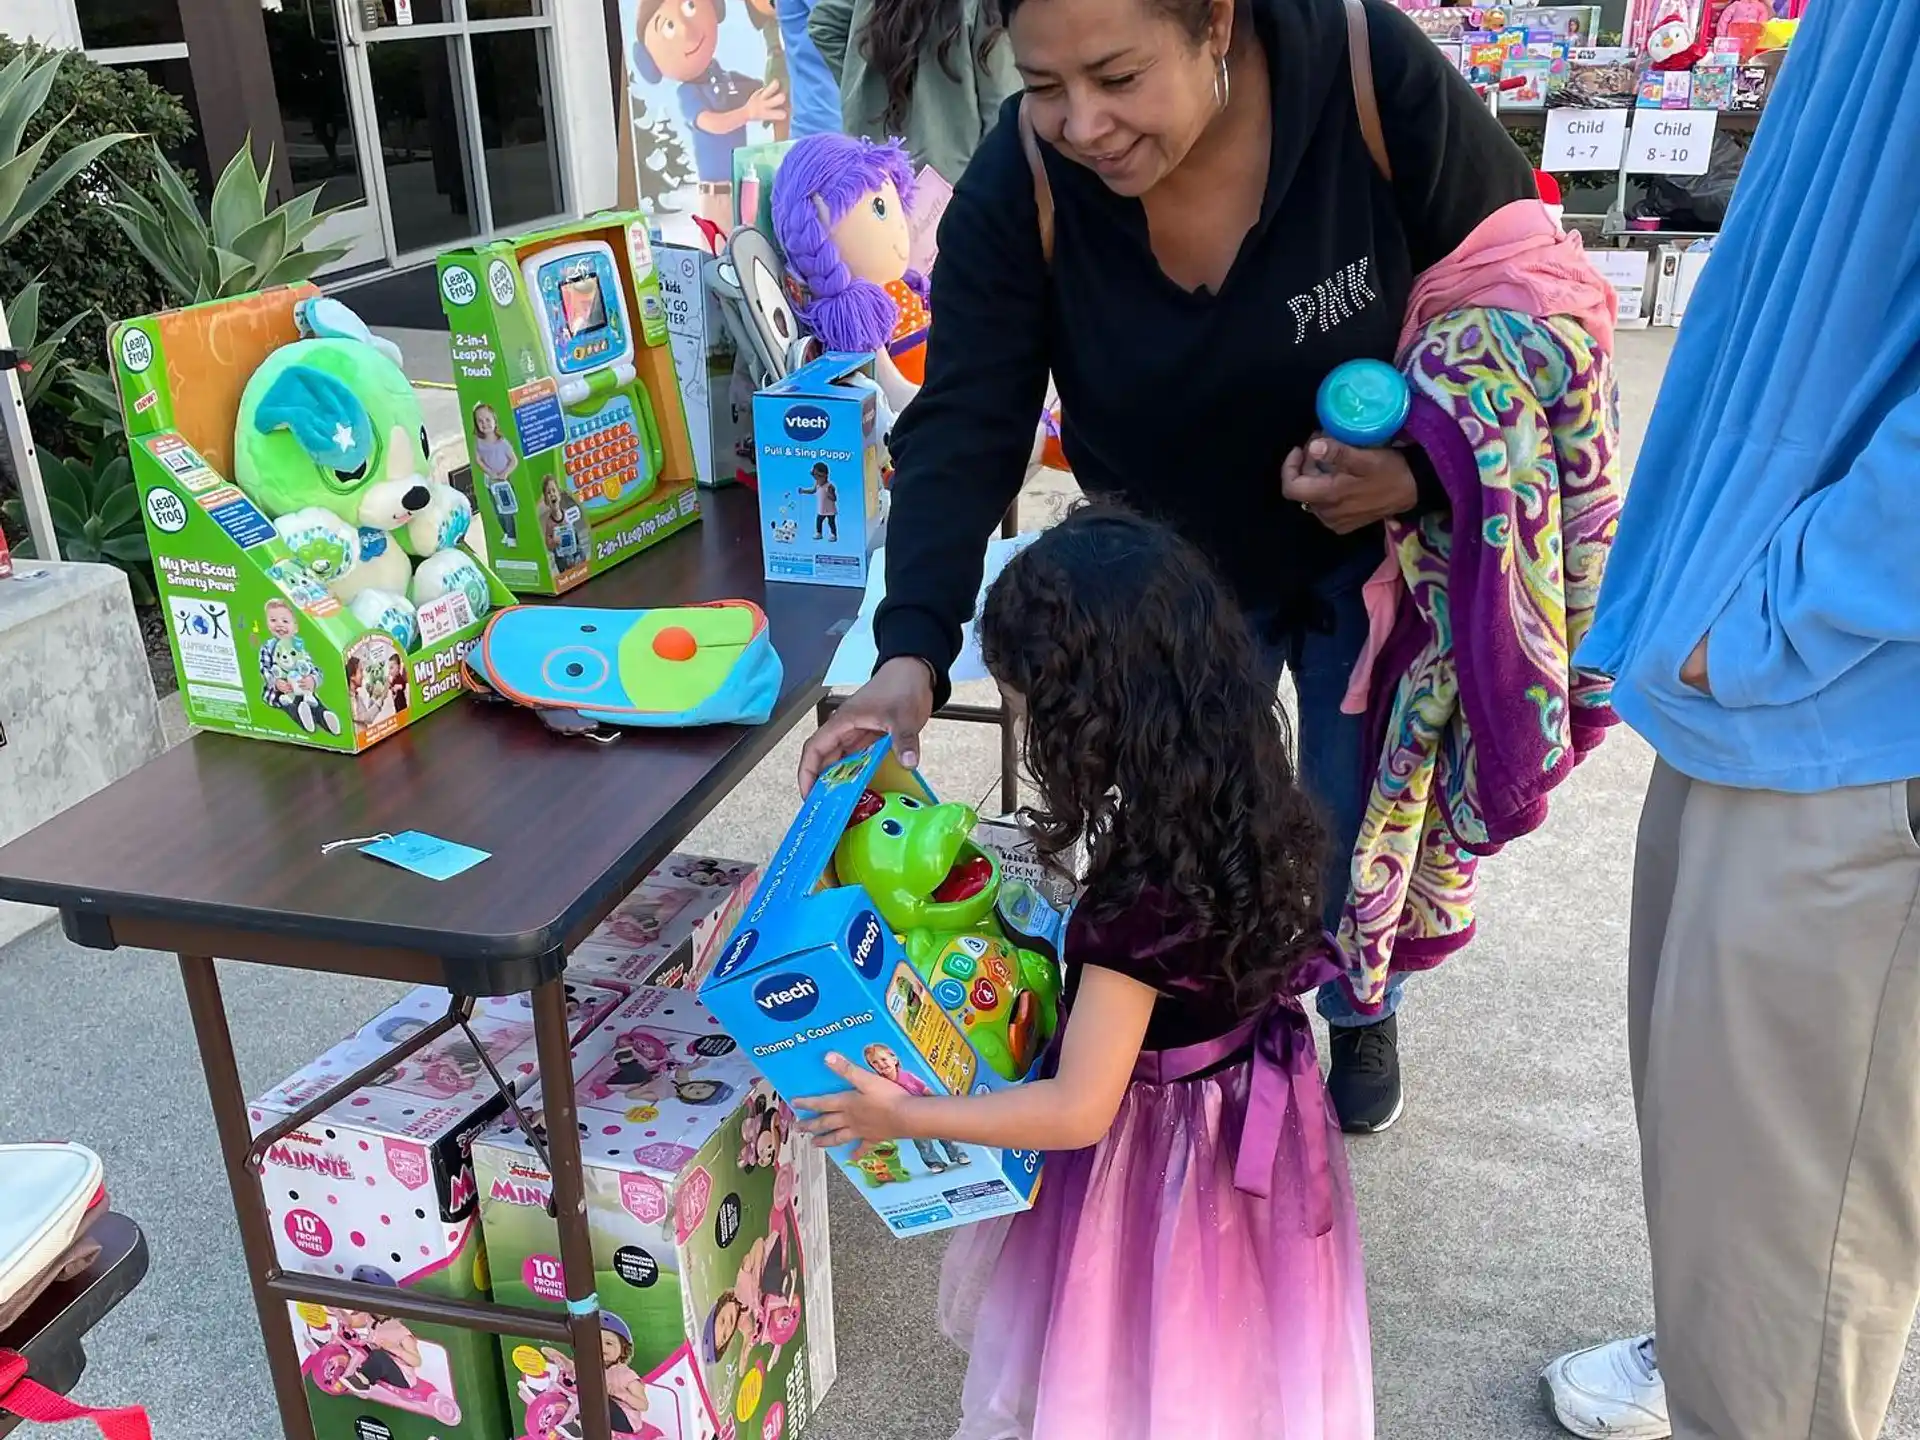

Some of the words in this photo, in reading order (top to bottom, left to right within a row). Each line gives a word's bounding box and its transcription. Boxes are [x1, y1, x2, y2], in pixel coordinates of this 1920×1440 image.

[1567, 121, 1604, 135] Child
[1654, 122, 1692, 137] Child
[1566, 146, 1575, 159] 4
[1590, 145, 1599, 158] 7
[1647, 148, 1656, 161] 8
[1670, 148, 1689, 162] 10
[444, 271, 468, 288] Leap
[449, 283, 474, 300] Frog
[1286, 256, 1376, 344] PINK
[673, 299, 688, 313] GO
[125, 335, 147, 352] Leap
[455, 333, 489, 346] 2-in-1
[128, 348, 149, 366] Frog
[452, 348, 496, 363] LeapTop
[461, 365, 493, 377] Touch
[785, 415, 828, 429] vtech
[764, 445, 783, 456] Pull
[795, 448, 817, 459] Sing
[820, 449, 852, 462] Puppy
[150, 495, 177, 512] Leap
[156, 508, 184, 525] Frog
[159, 555, 179, 576] My
[180, 558, 200, 574] Pal
[201, 561, 237, 578] Scout
[167, 573, 208, 592] Smarty
[208, 578, 236, 593] Paws
[413, 660, 435, 684] My
[435, 647, 456, 673] Pal
[421, 672, 462, 702] Smarty
[853, 917, 880, 968] vtech
[720, 930, 753, 978] vtech
[955, 959, 969, 970] 2
[756, 980, 818, 1010] vtech
[945, 988, 957, 997] 1
[753, 1037, 795, 1057] Chomp
[796, 1033, 807, 1043] &
[806, 1021, 844, 1041] Count
[845, 1011, 874, 1029] Dino
[268, 1144, 353, 1178] MINNIE
[295, 1231, 323, 1244] FRONT
[296, 1240, 324, 1253] WHEEL
[533, 1276, 562, 1290] FRONT
[534, 1285, 565, 1299] WHEEL
